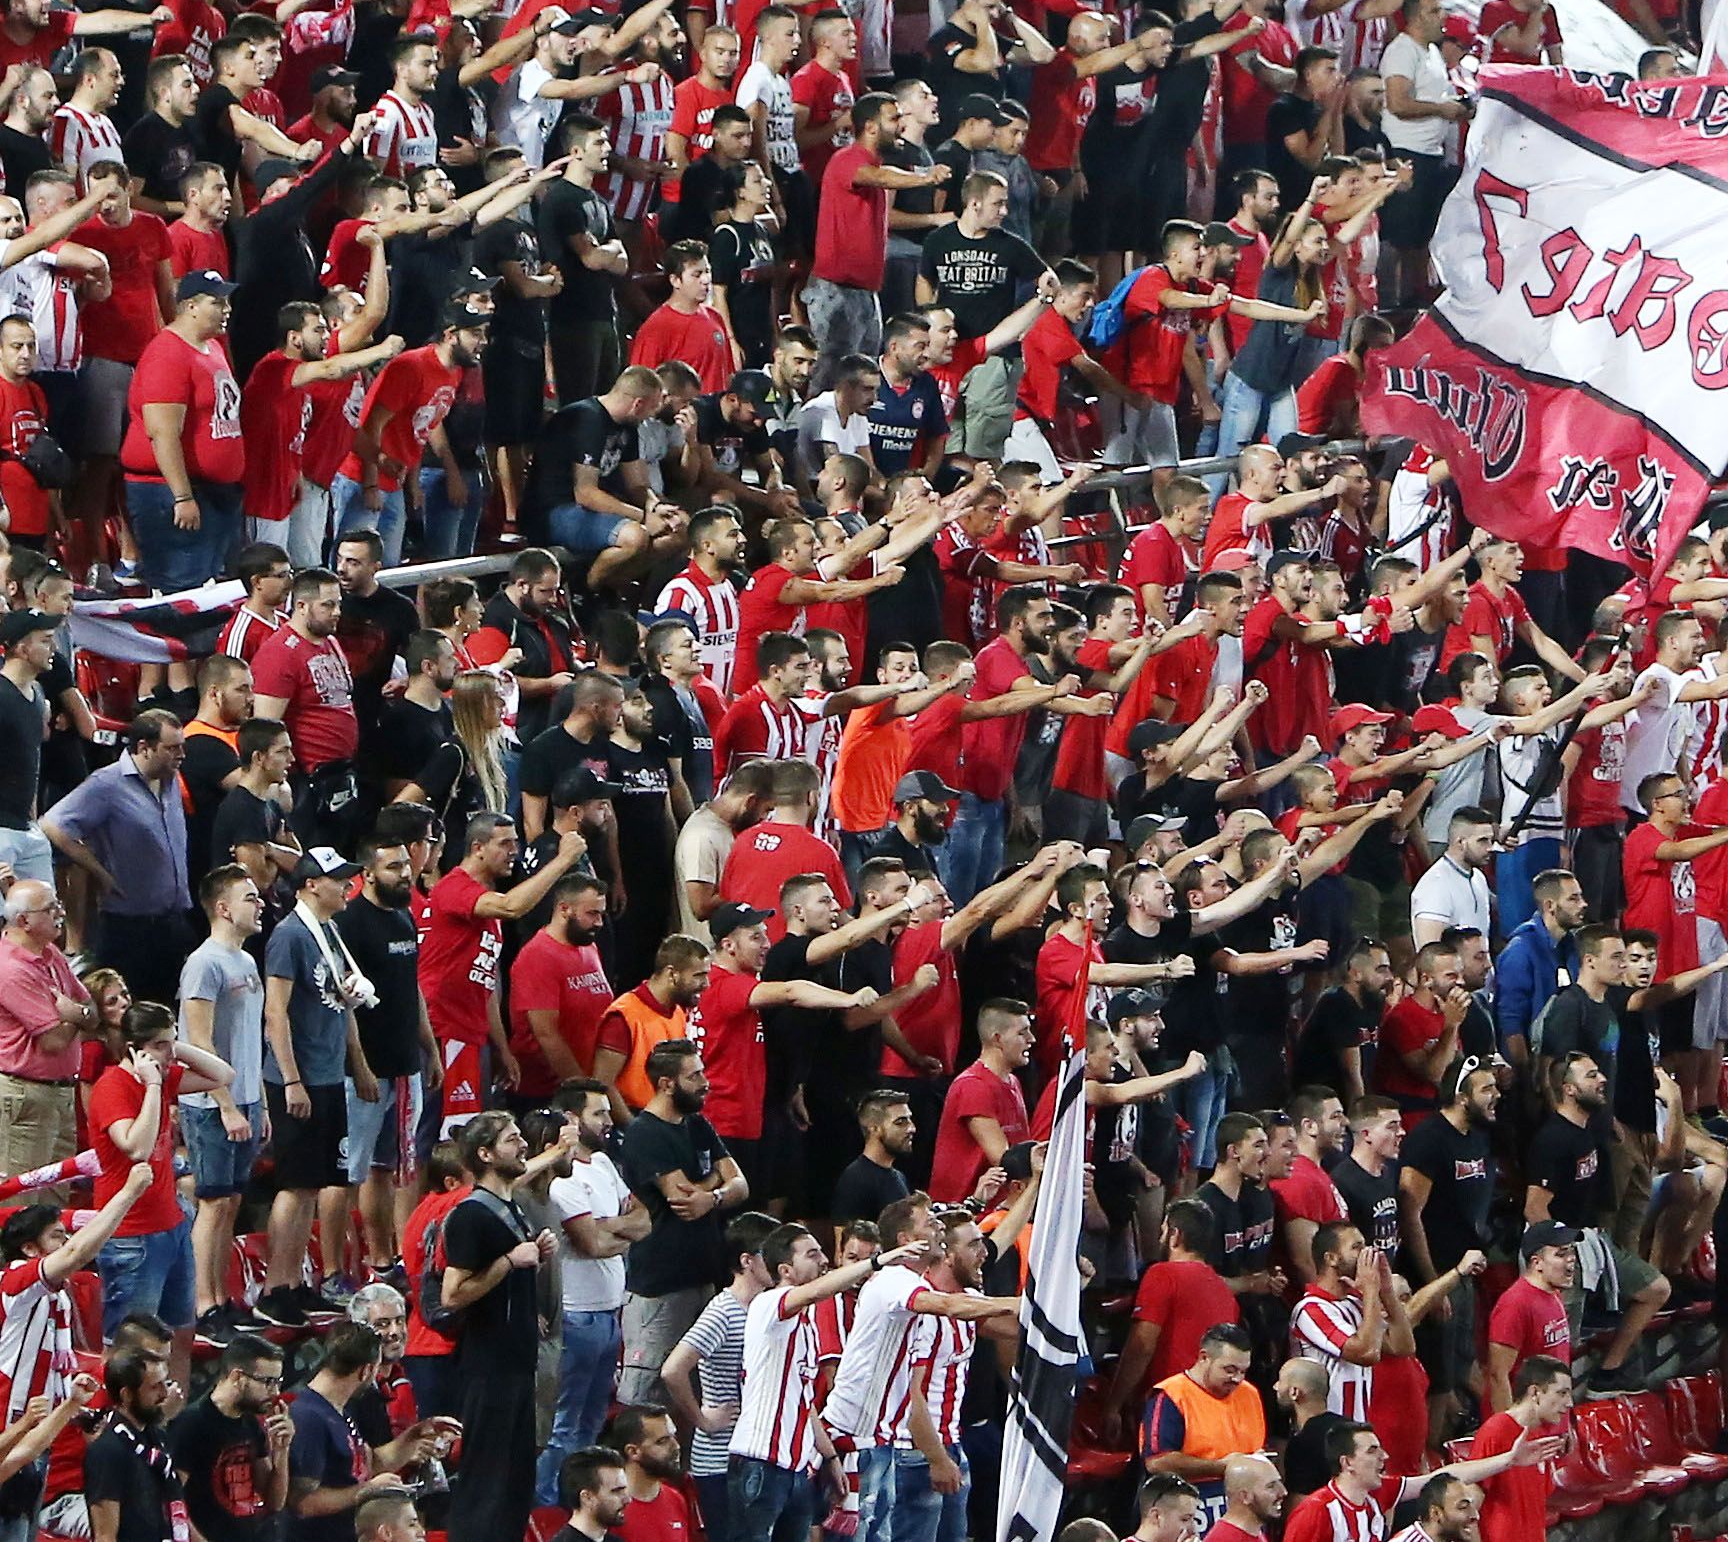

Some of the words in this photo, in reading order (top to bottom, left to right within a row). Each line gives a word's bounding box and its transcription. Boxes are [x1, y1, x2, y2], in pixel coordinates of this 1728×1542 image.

[944, 249, 998, 266] LONSDALE
[936, 265, 965, 283] EAT
[868, 421, 919, 440] SIEMENS
